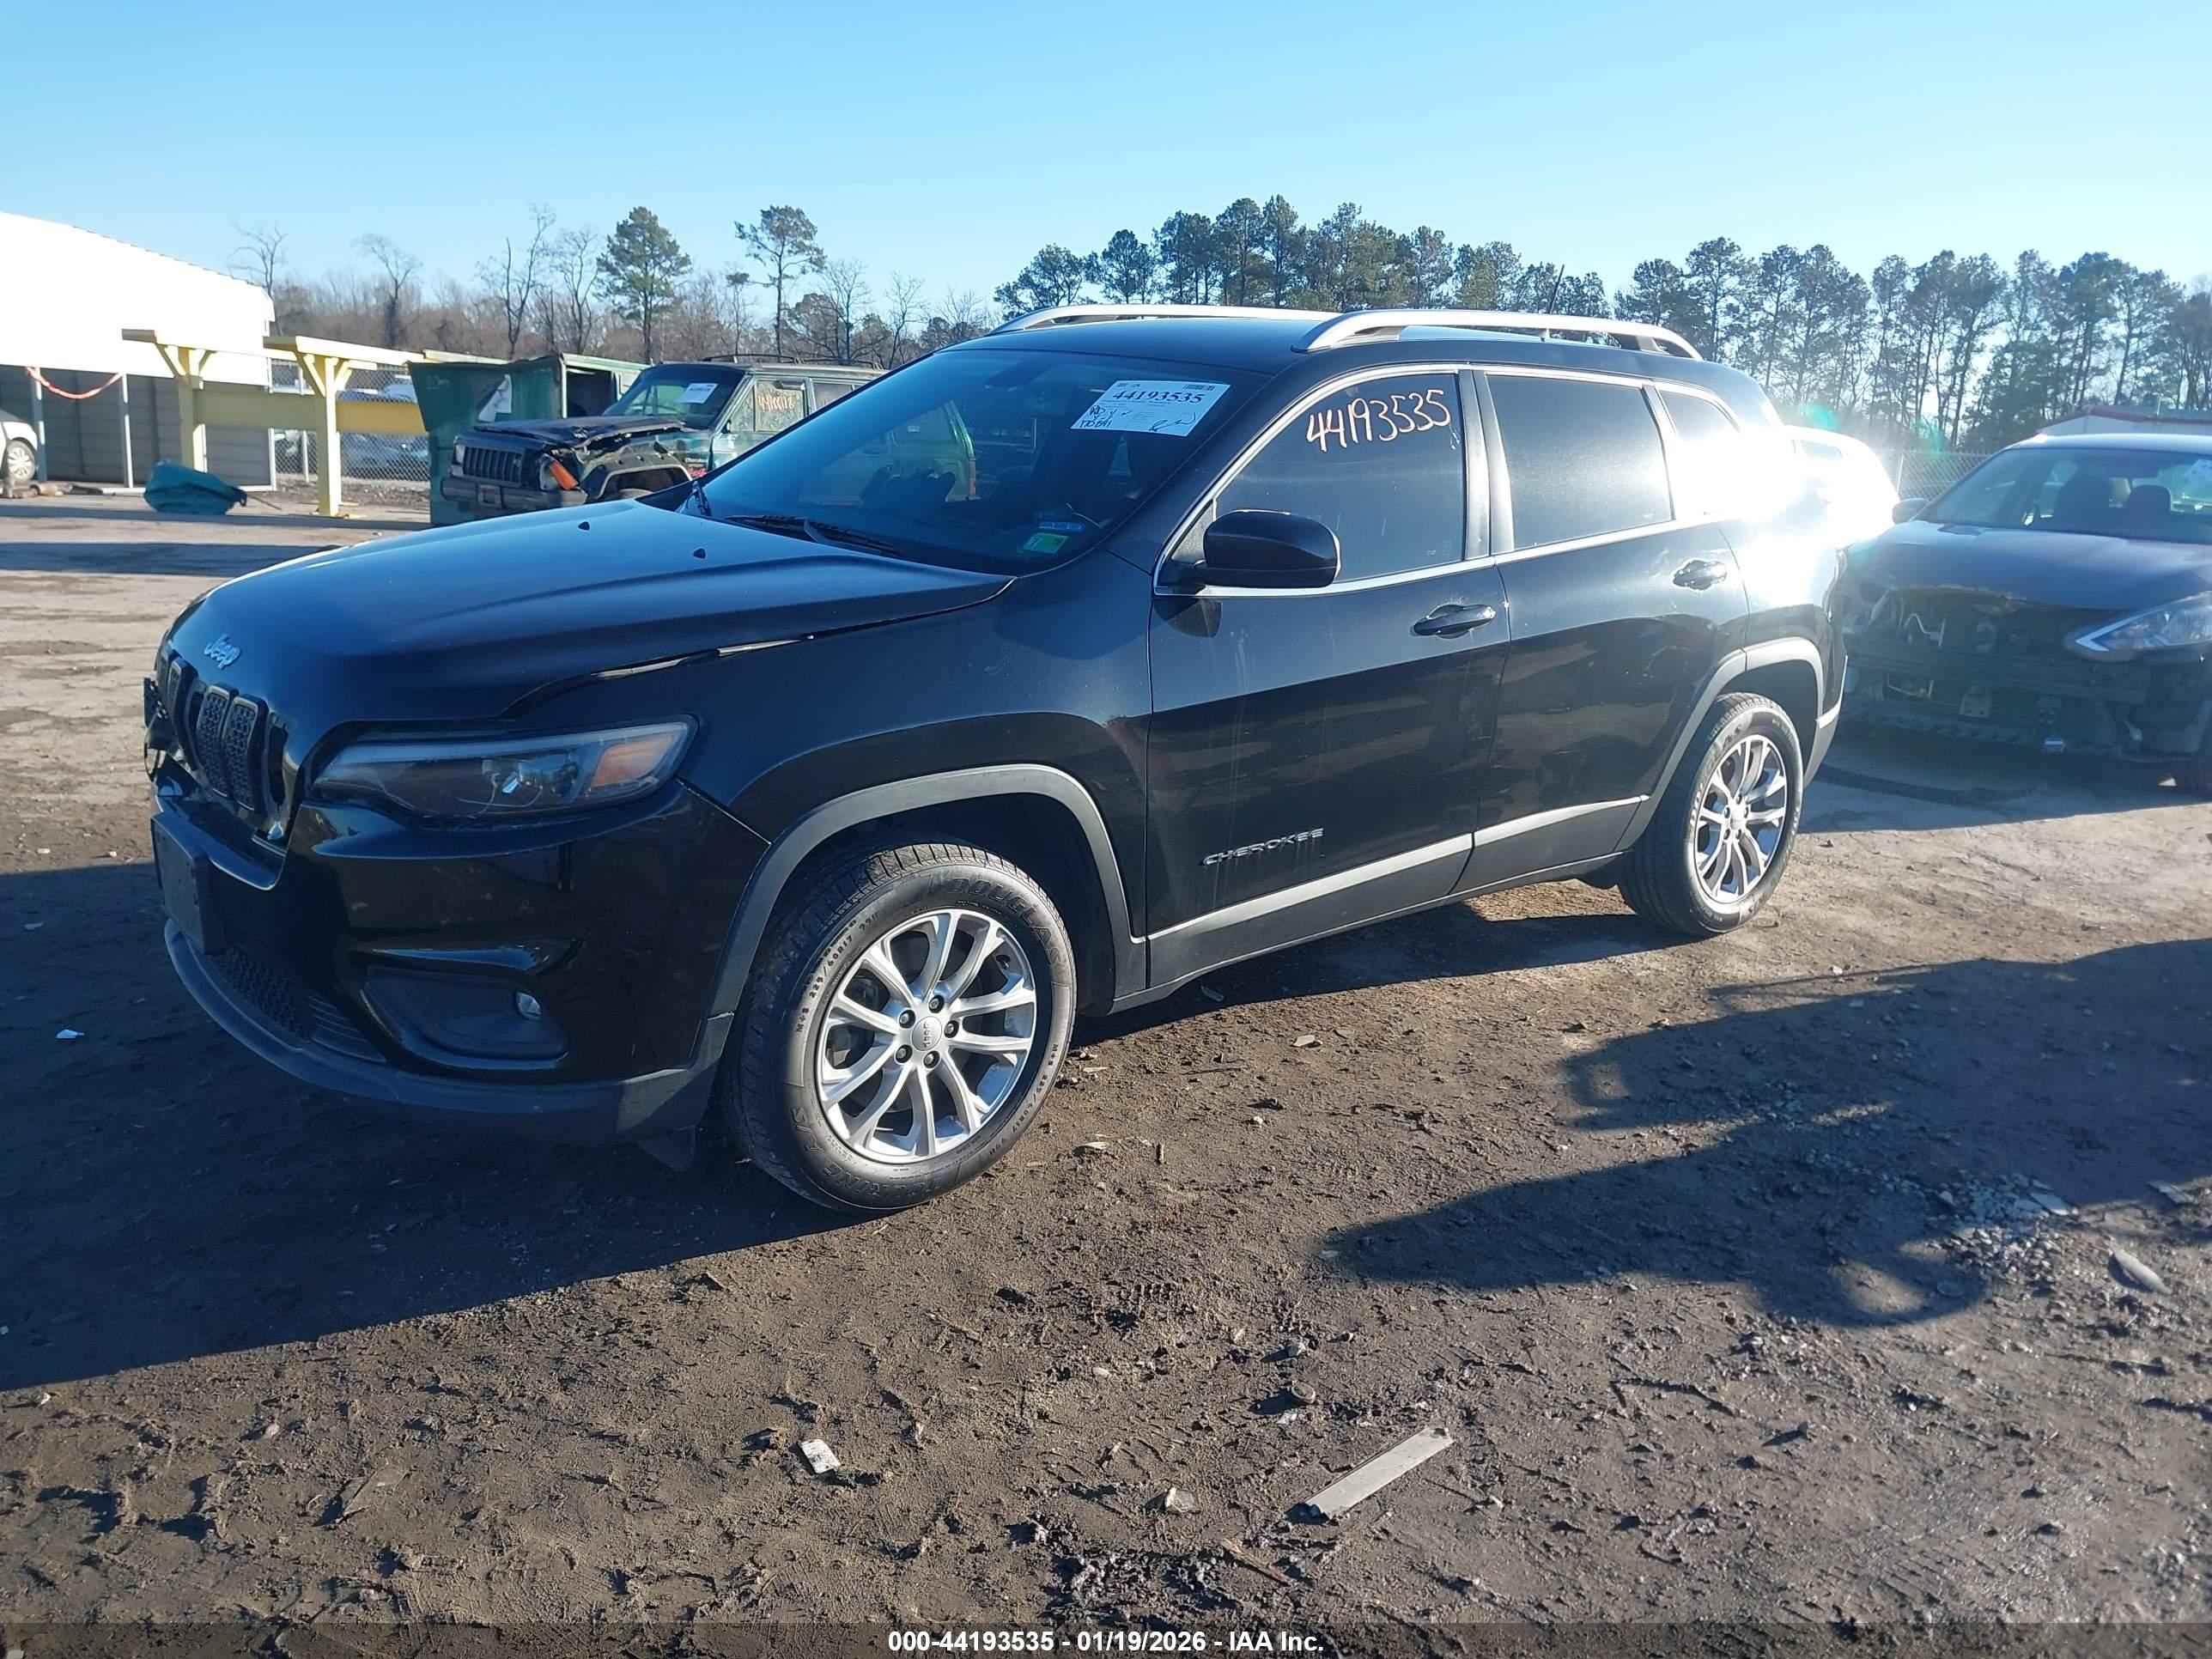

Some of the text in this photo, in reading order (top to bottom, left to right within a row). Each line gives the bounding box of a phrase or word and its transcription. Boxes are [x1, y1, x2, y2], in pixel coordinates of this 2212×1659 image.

[1113, 390, 1205, 404] 44193535
[1307, 389, 1451, 453] 44193535
[204, 633, 241, 670] Jeep
[1203, 828, 1323, 865] CHEROKEE
[946, 878, 1063, 965] DOUGLAS
